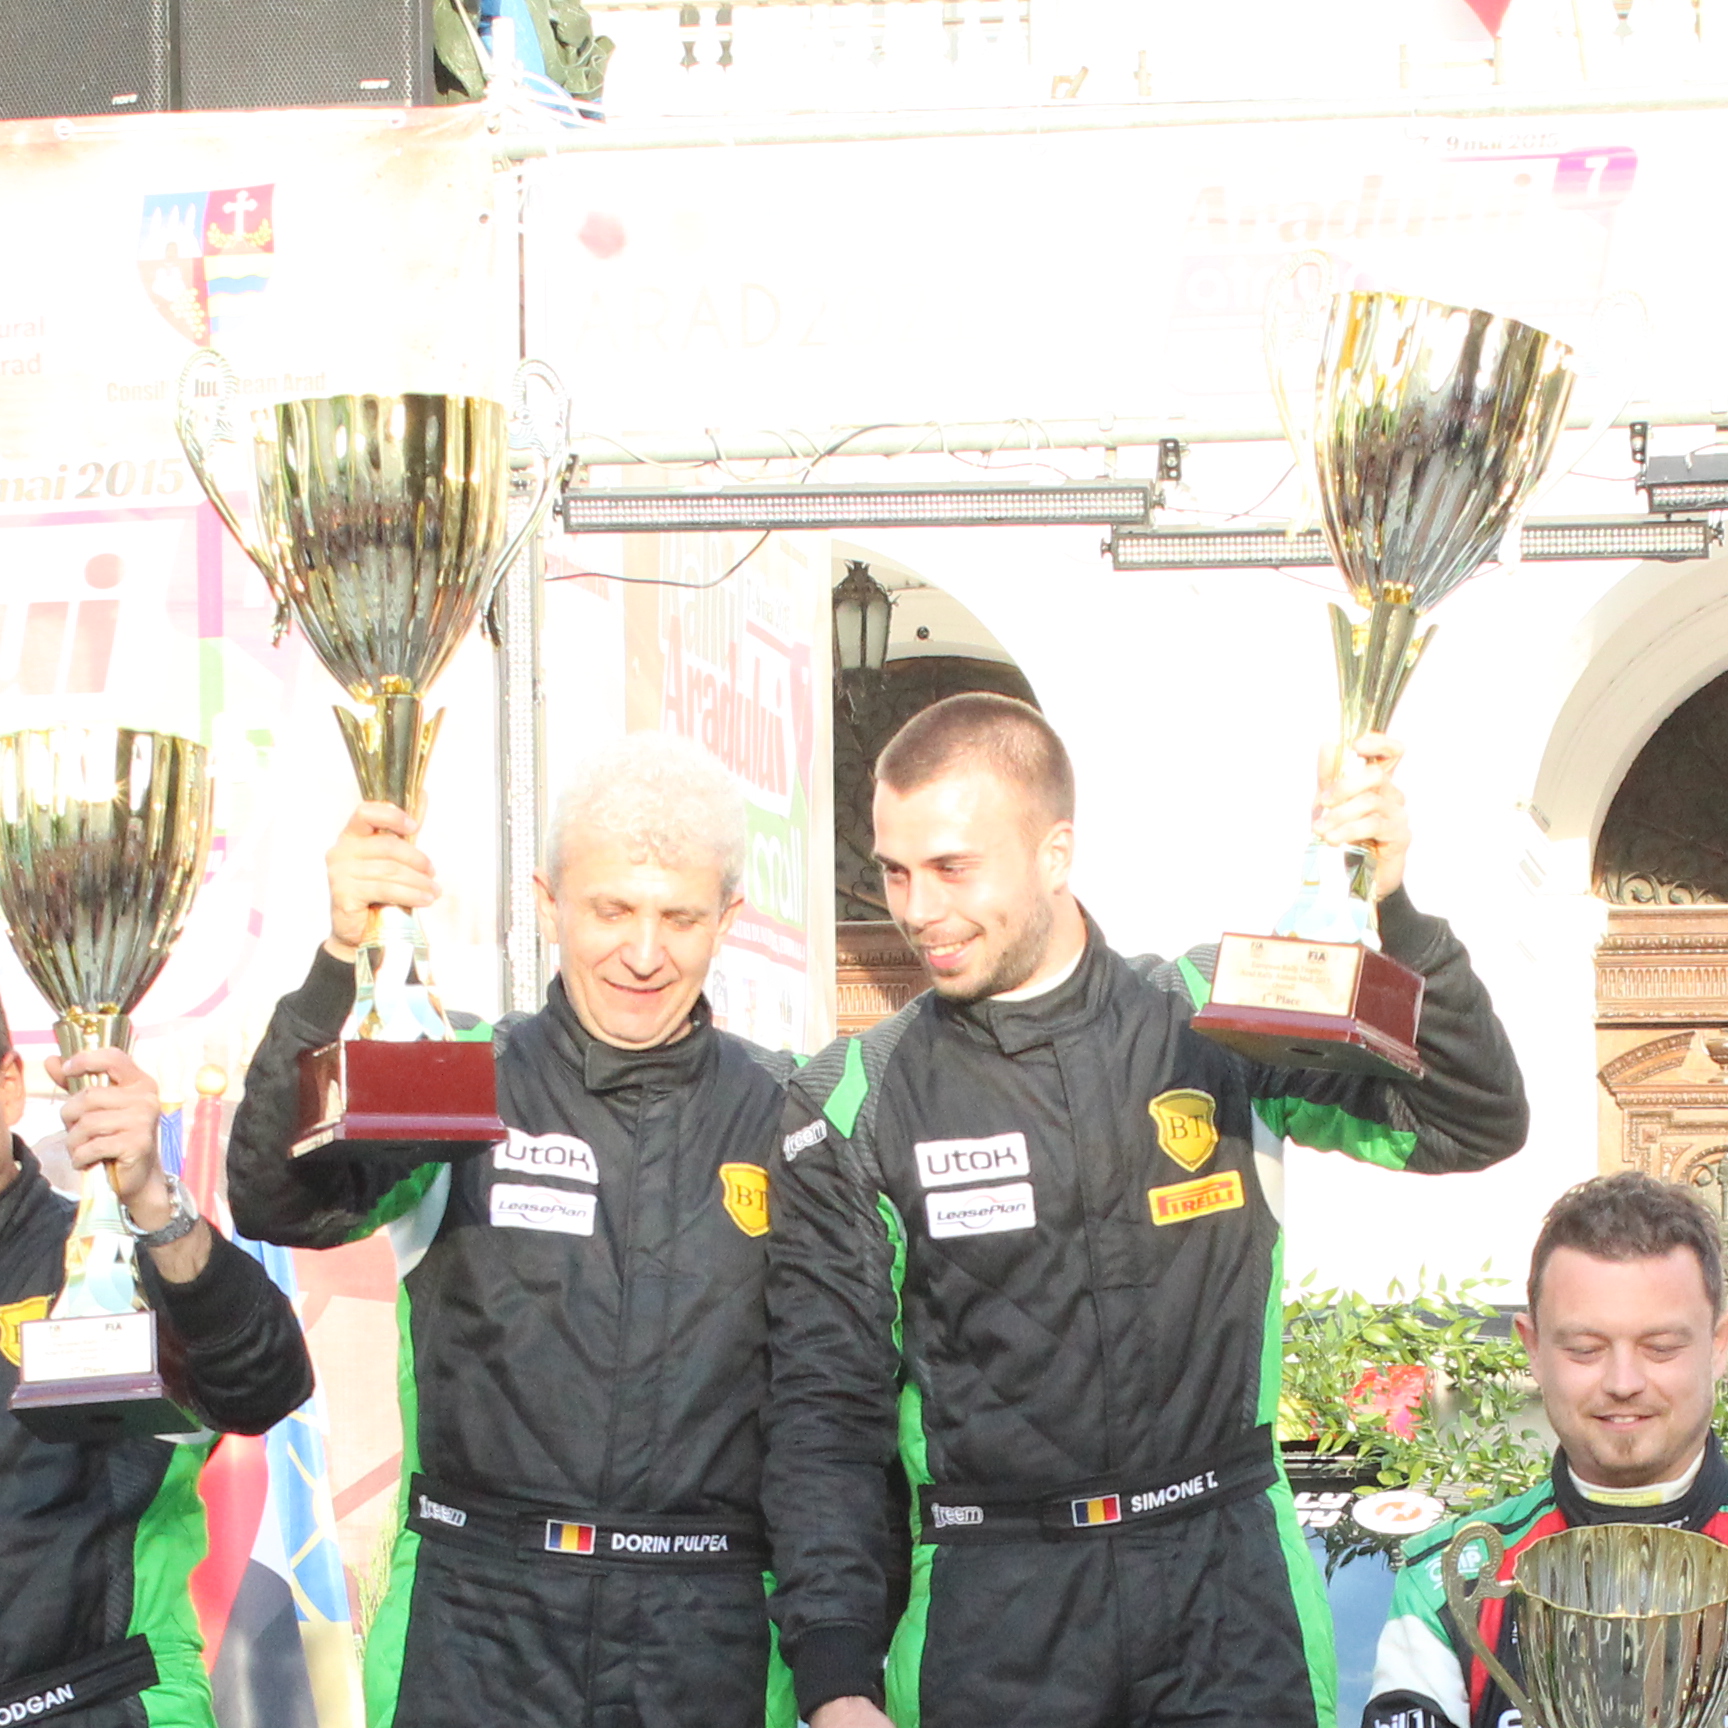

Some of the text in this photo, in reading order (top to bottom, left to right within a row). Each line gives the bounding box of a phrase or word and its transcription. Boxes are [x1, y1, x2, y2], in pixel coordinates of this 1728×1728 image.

[75, 456, 185, 500] 2015
[1168, 1114, 1208, 1139] BT
[498, 1199, 588, 1220] LeasePlan
[936, 1200, 1027, 1222] LeasePlan
[1156, 1180, 1237, 1218] PIRELLI
[932, 1502, 984, 1527] freem
[1130, 1479, 1204, 1514] SIMONE
[611, 1533, 672, 1554] DORIN
[674, 1534, 729, 1553] PULPEA
